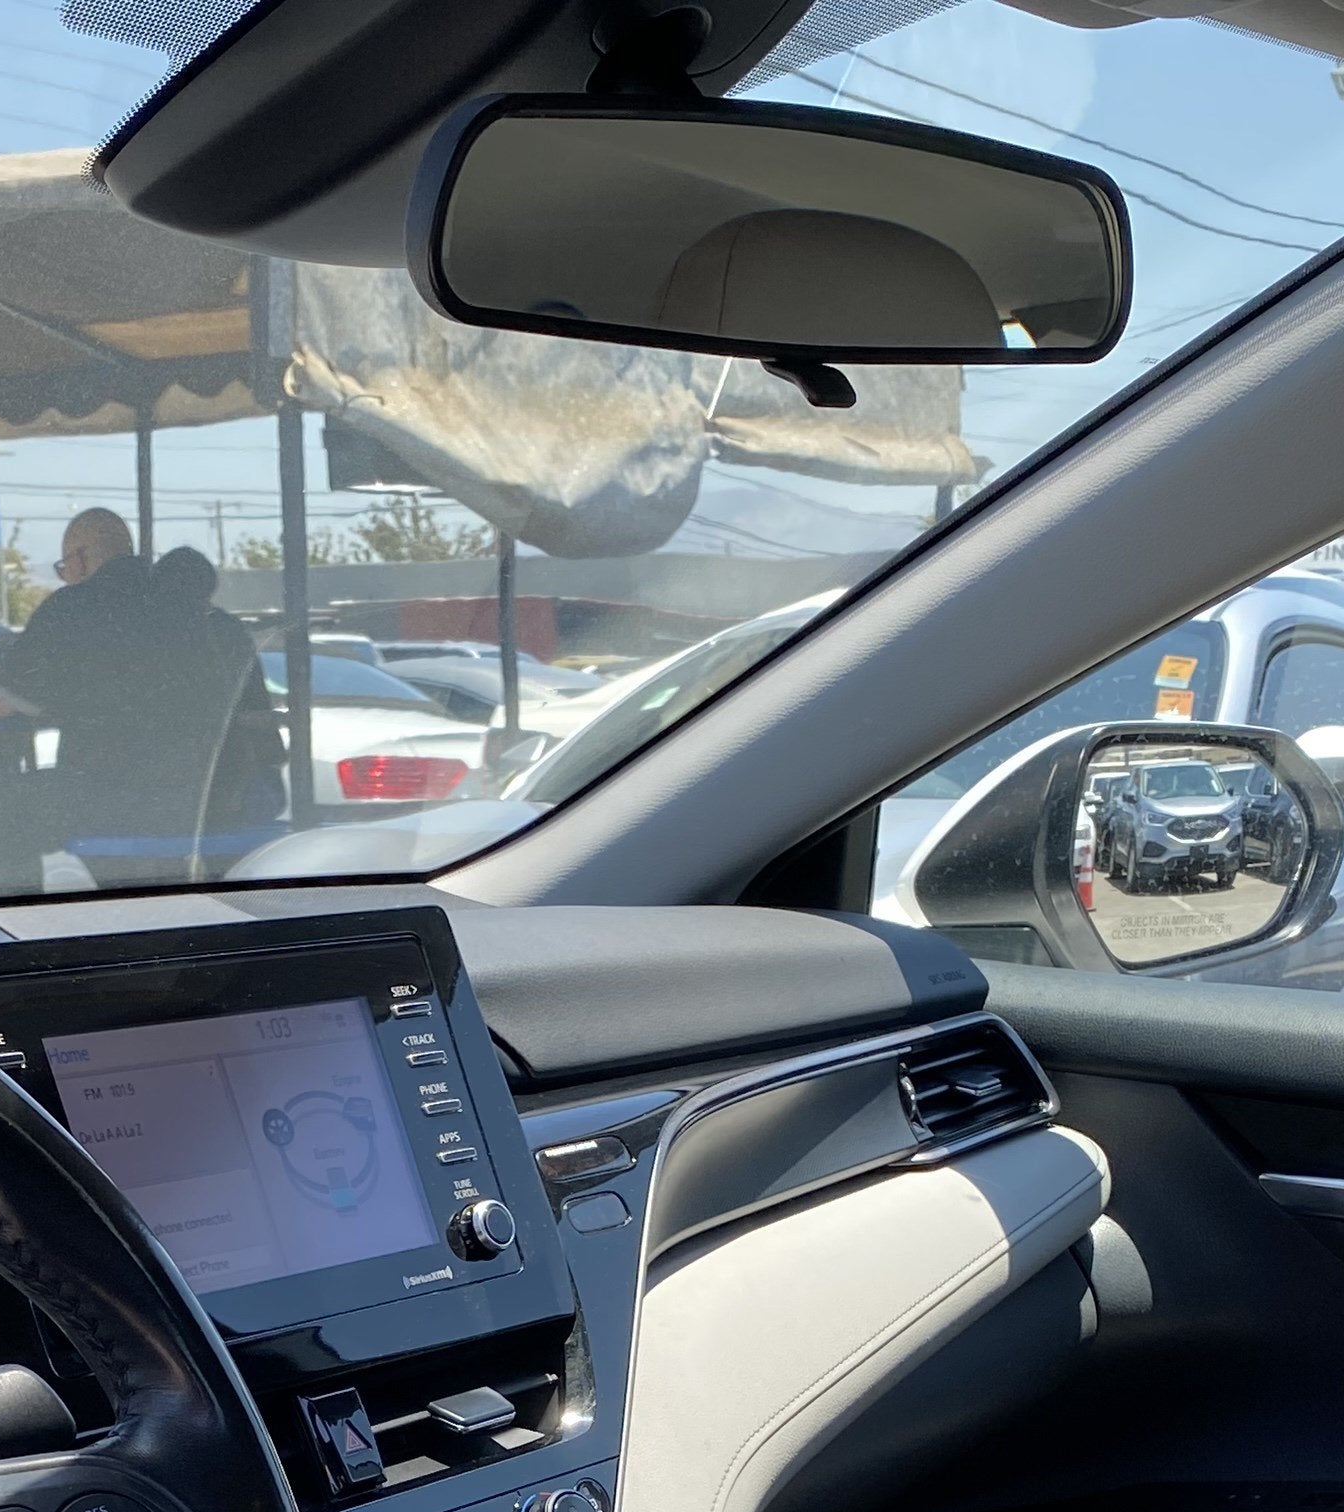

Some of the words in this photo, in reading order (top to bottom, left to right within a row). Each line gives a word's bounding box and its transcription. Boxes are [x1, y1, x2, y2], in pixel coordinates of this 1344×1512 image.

[256, 1016, 292, 1040] 1:03
[49, 1048, 91, 1065] Home
[84, 1088, 103, 1101] FM
[419, 1081, 448, 1096] PHONE
[439, 1131, 461, 1144] APPS
[453, 1178, 473, 1189] TUNE
[453, 1187, 480, 1200] SCROLL
